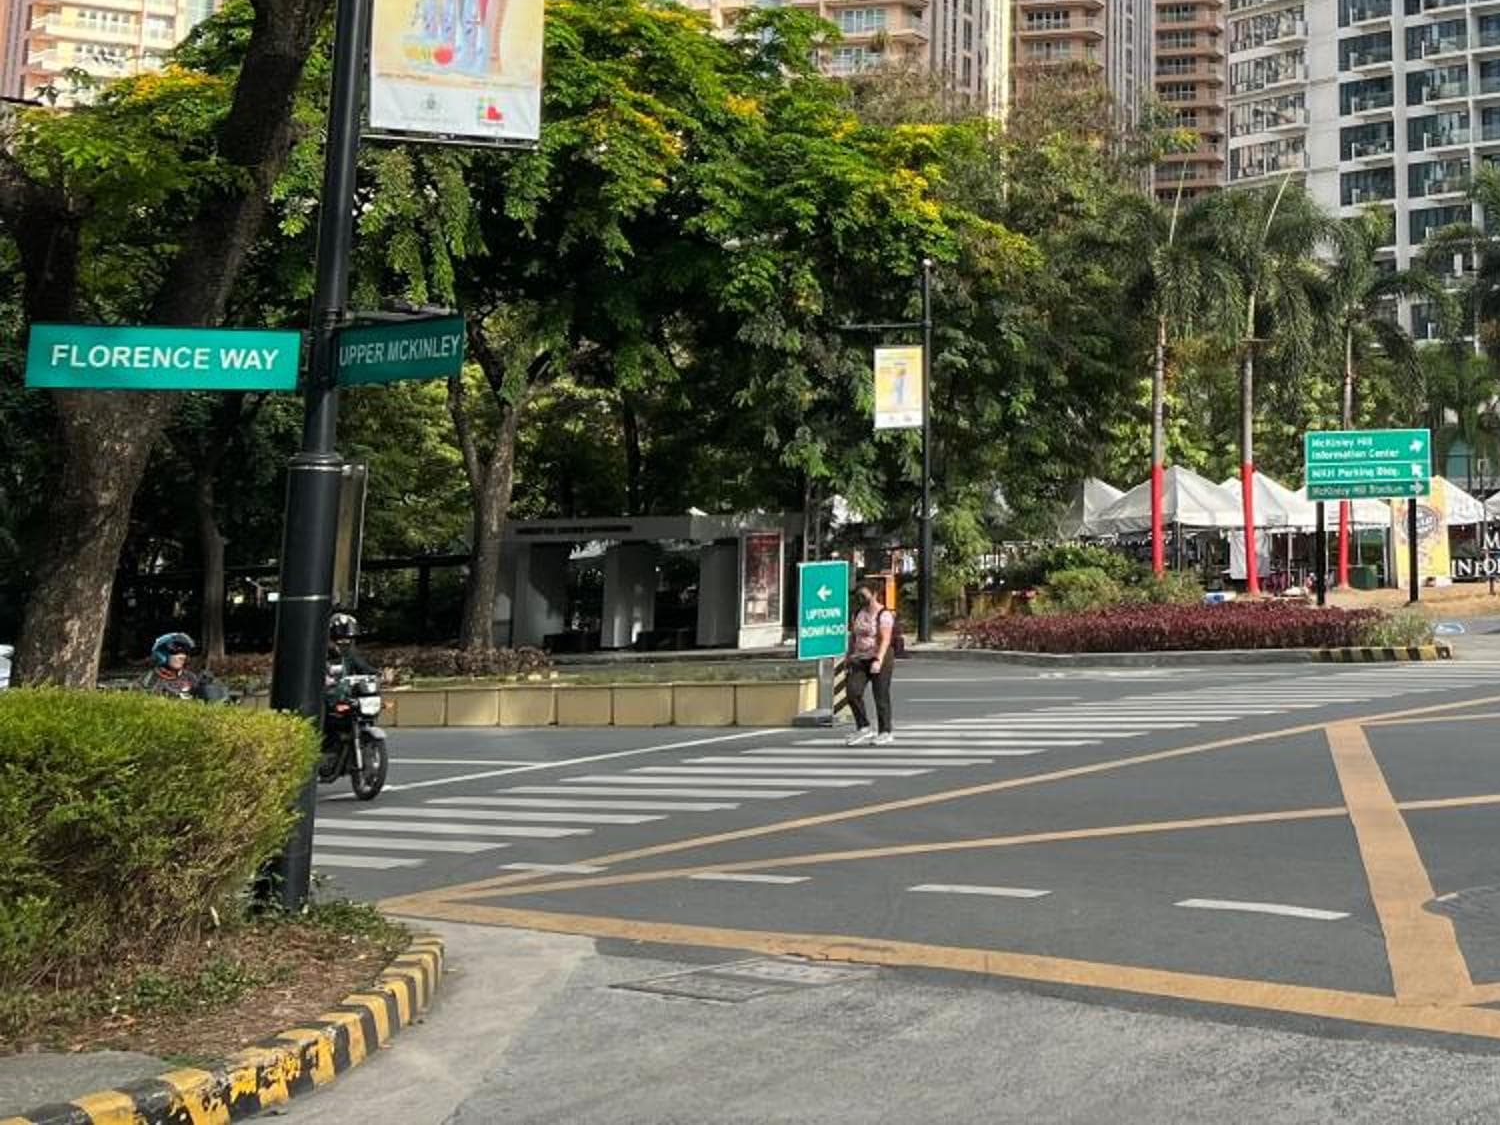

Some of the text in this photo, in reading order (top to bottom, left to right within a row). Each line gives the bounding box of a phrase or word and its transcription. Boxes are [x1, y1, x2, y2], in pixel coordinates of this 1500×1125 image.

[339, 331, 461, 366] UPPER MCKINLEY
[51, 344, 280, 372] FLORENCE WAY
[1311, 436, 1374, 448] McKinley Hill
[1311, 448, 1400, 460] Information Center
[1337, 467, 1375, 478] Parking
[1311, 485, 1350, 496] McKinley
[1352, 484, 1367, 493] Hill
[805, 608, 841, 620] UPTOWN
